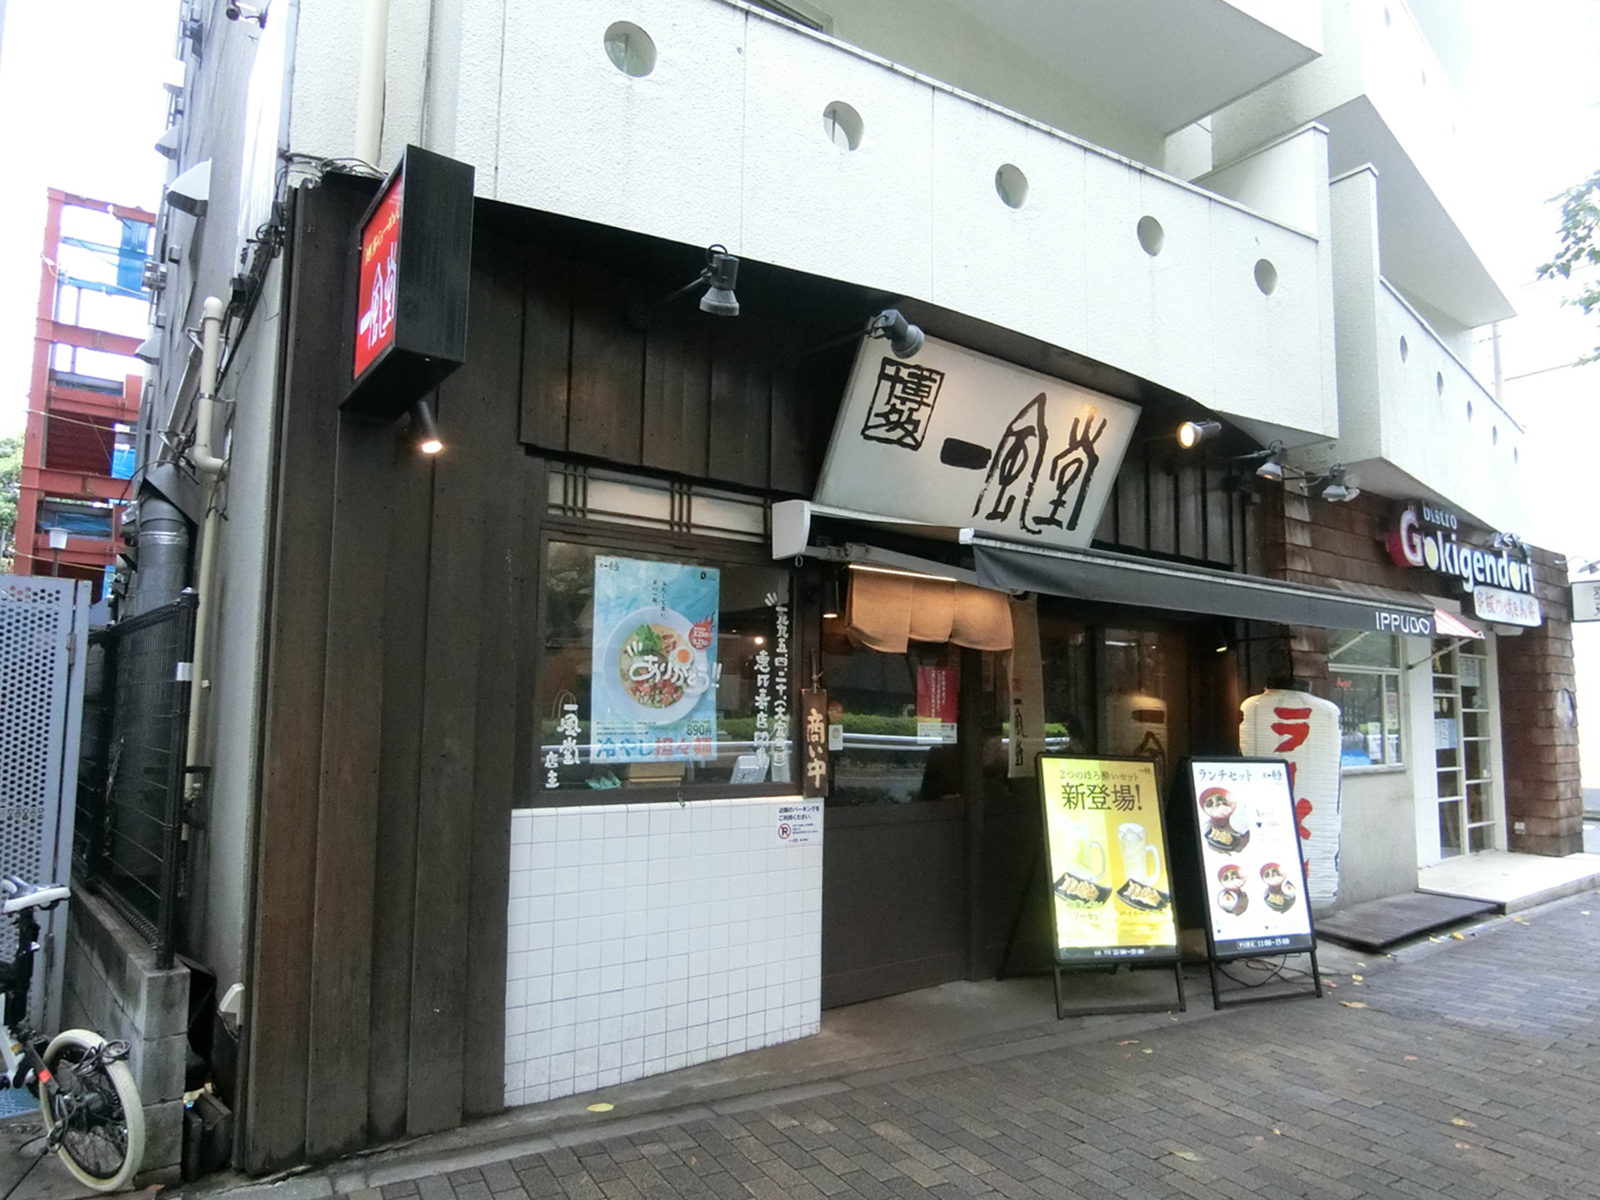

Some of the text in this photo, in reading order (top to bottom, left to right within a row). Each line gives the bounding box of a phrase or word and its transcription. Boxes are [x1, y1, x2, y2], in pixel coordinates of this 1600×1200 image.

[863, 360, 942, 450] 博多
[940, 392, 1107, 534] 一風堂
[1400, 509, 1535, 594] Gokigendori
[1375, 611, 1430, 634] IPPUDO
[556, 703, 582, 765] 一風堂
[686, 724, 712, 736] 890円
[806, 708, 827, 789] 商い中
[544, 750, 560, 788] 店主
[1199, 769, 1253, 782] ランチセット
[1061, 782, 1143, 812] 新登場!
